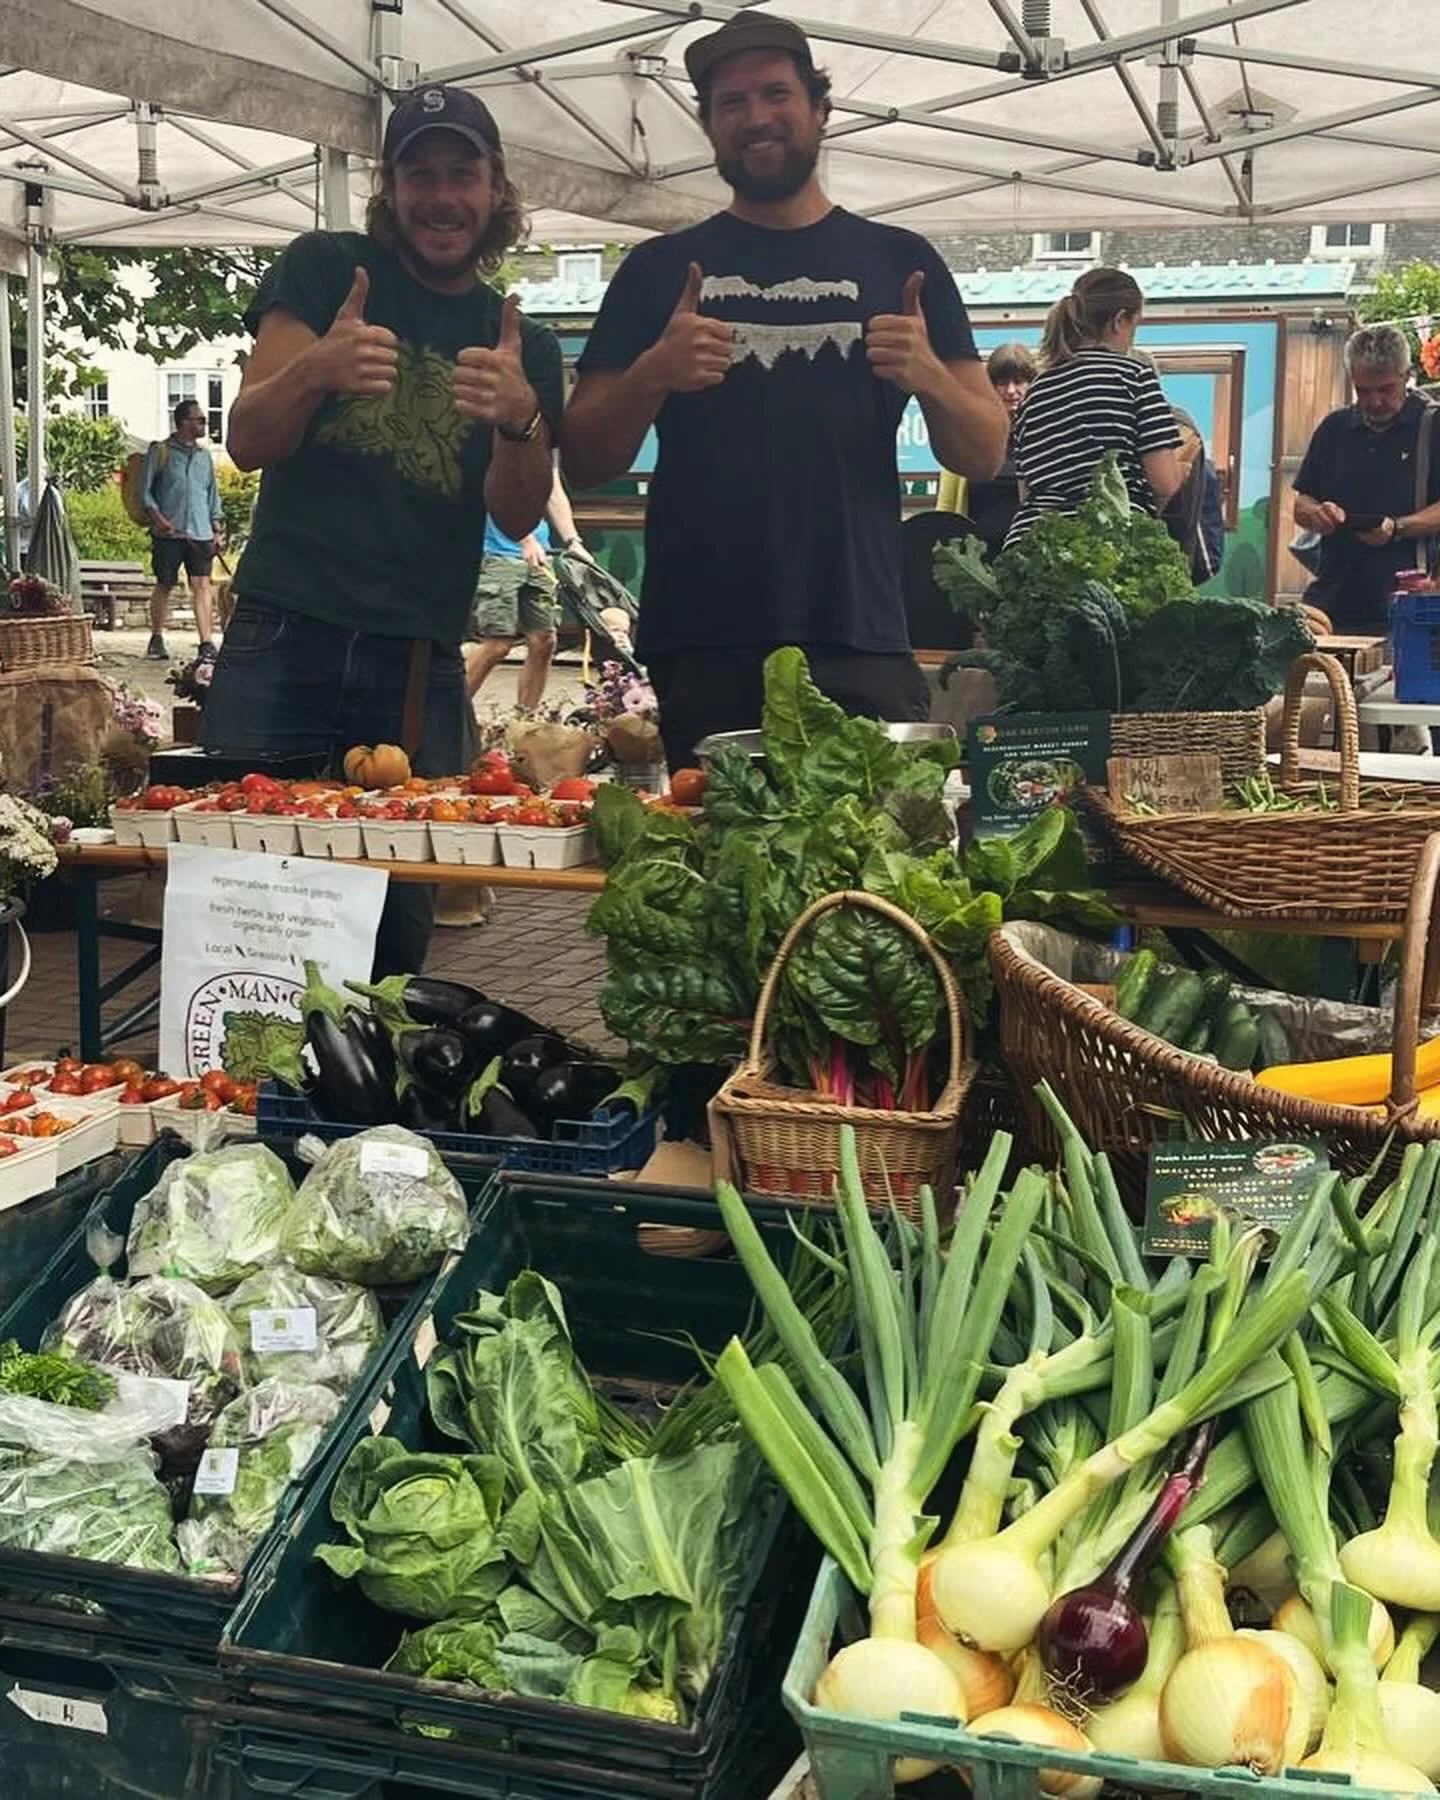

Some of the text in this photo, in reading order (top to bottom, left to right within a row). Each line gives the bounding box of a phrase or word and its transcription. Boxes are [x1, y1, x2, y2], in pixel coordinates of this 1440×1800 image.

[423, 89, 446, 113] S
[228, 978, 281, 1005] MAN
[1182, 1153, 1207, 1162] Local
